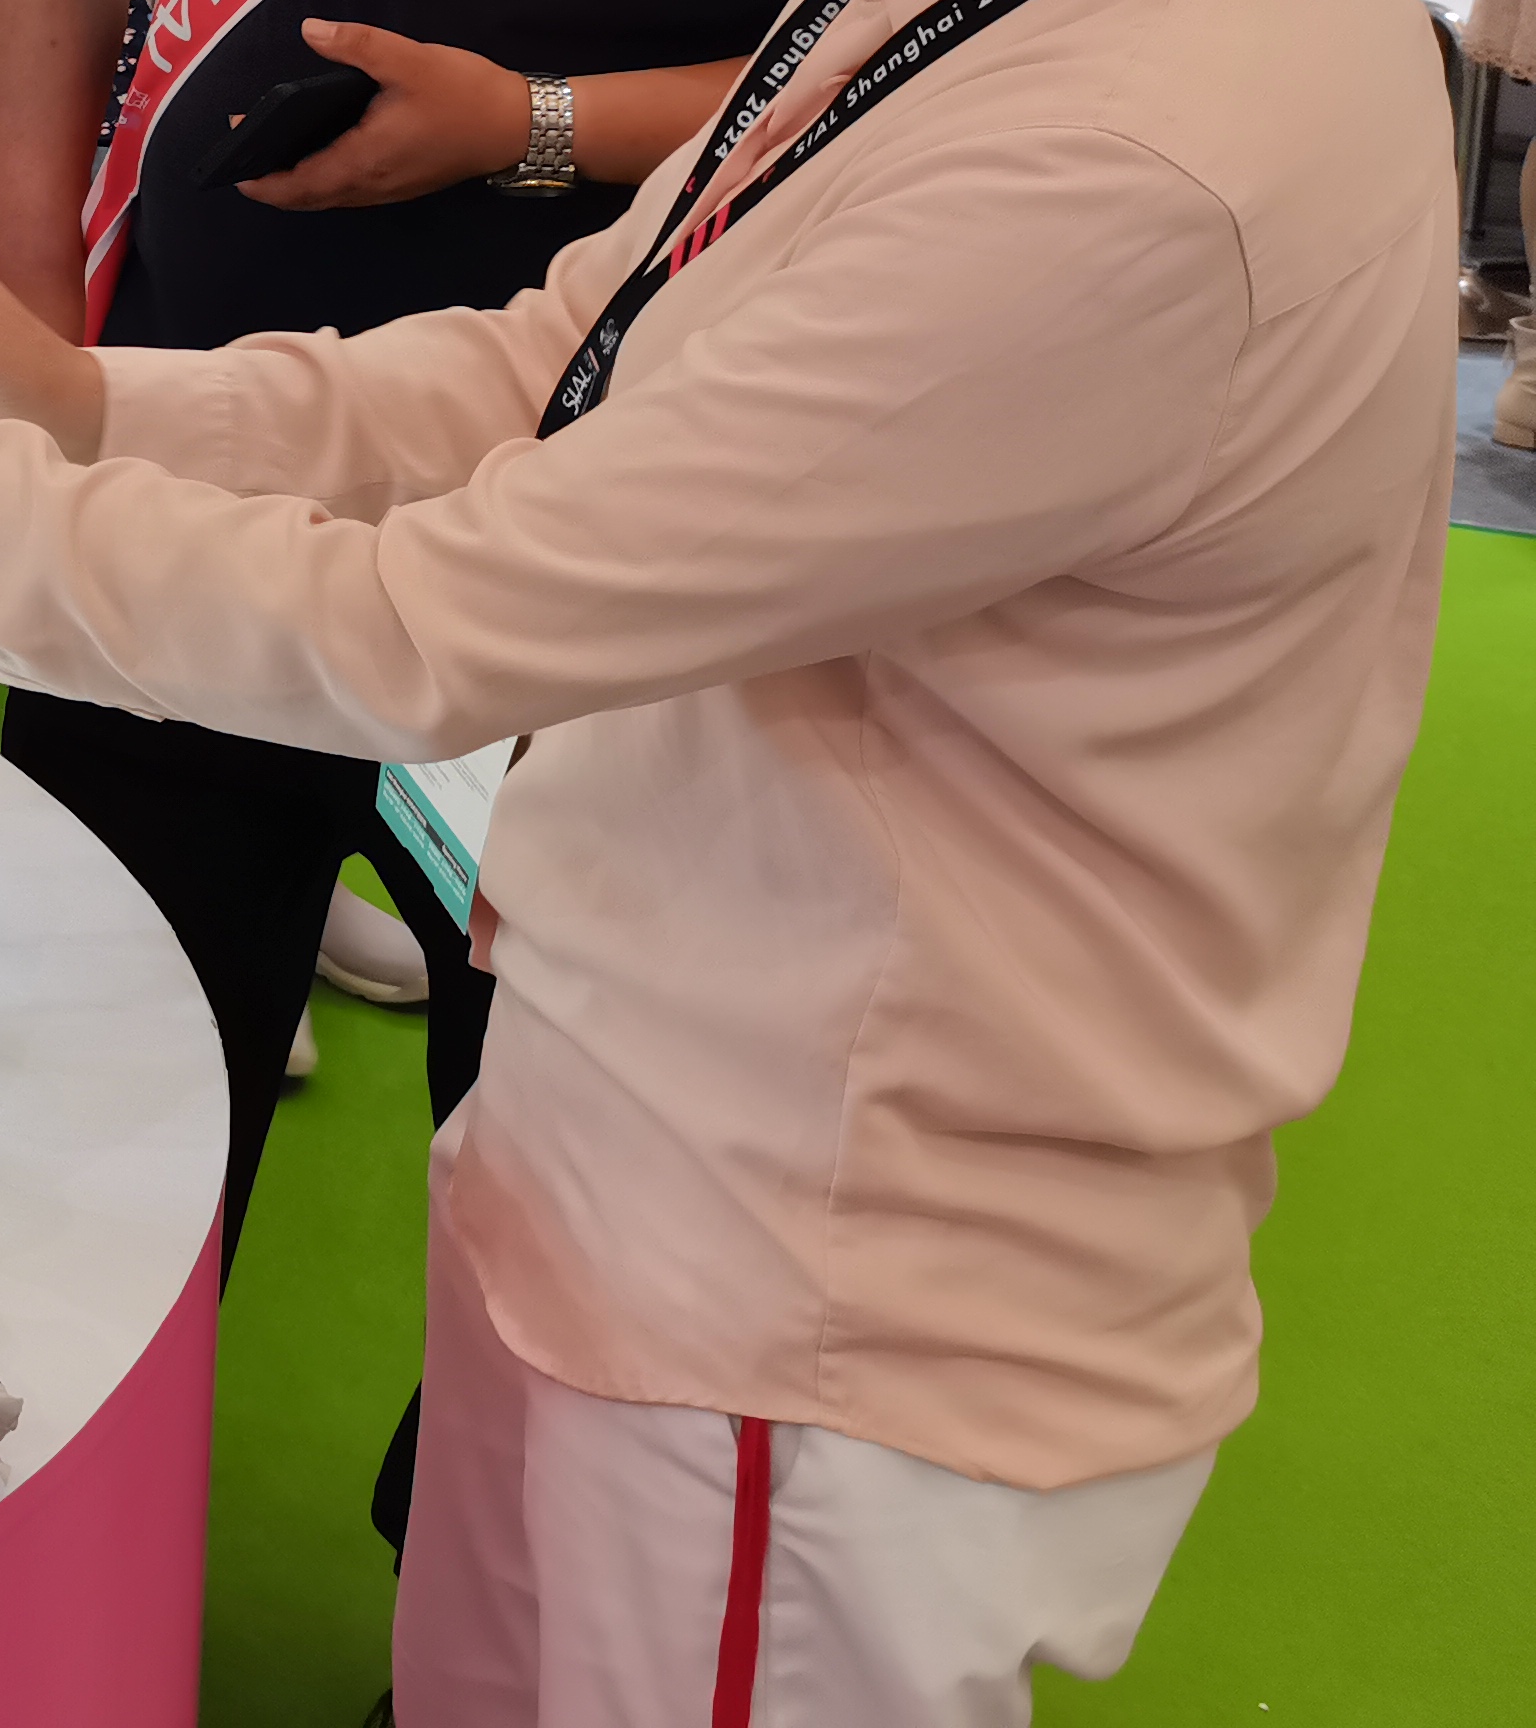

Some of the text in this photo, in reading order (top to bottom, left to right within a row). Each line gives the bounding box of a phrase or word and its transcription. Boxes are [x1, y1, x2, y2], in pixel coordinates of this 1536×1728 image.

[794, 109, 839, 159] SIAL
[845, 2, 965, 109] Shanghai
[562, 365, 592, 416] SIAL
